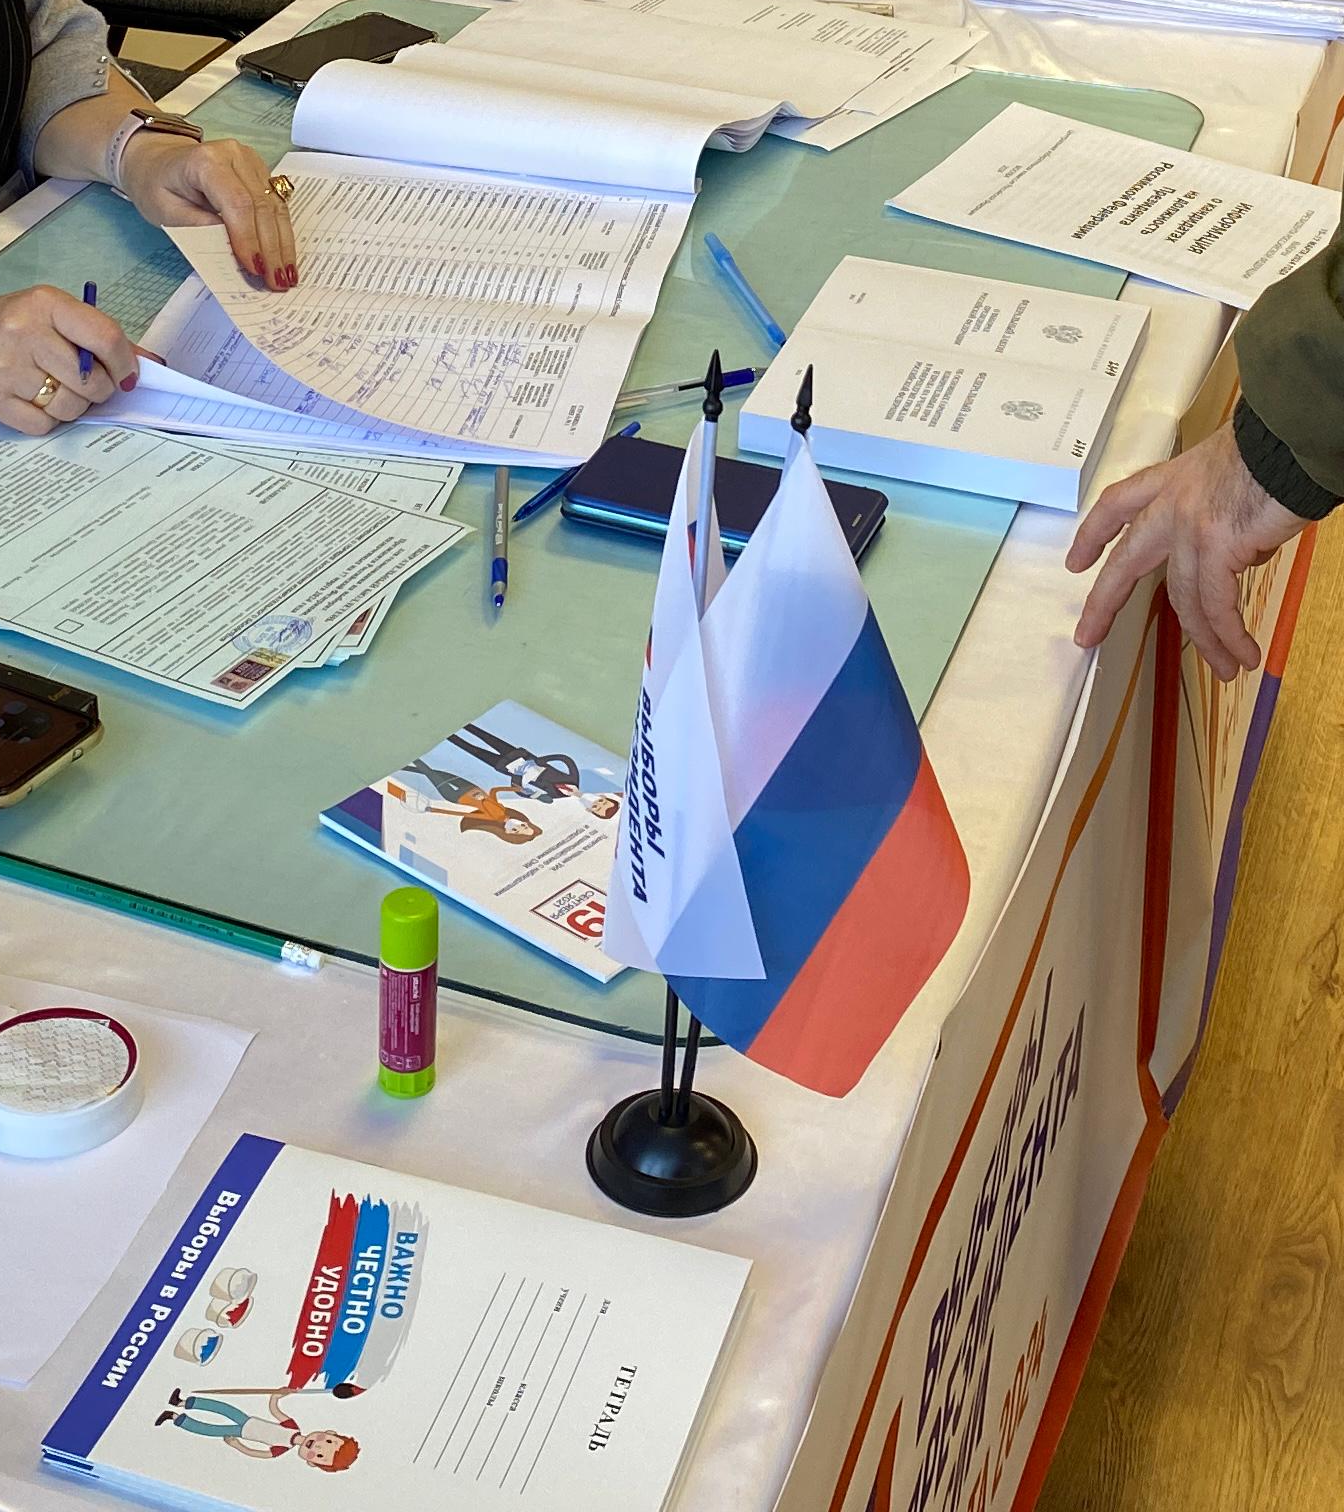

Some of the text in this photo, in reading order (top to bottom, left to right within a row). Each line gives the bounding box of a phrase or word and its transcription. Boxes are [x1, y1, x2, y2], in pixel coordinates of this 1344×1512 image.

[1071, 162, 1174, 239] Российской Федерации
[1119, 187, 1176, 225] Президента
[1141, 191, 1199, 234] на должность
[1165, 203, 1217, 243] кандидатах
[1187, 203, 1253, 254] ИНФОРМАЦИЯ
[642, 687, 665, 859] ВЫБОРЫ
[550, 891, 594, 919] СЕНТЯБРЯ
[553, 893, 576, 911] 2021
[916, 966, 1053, 1448] ВЫБОРЫ
[102, 1191, 241, 1387] Выборы в России
[343, 1246, 382, 1333] ЧЕСТНО
[381, 1232, 418, 1318] ВАЖНО
[302, 1266, 342, 1356] УДОБНО
[600, 1299, 611, 1314] для
[487, 1376, 505, 1406] школы
[509, 1383, 526, 1411] класса
[589, 1366, 637, 1451] ТЕТРАДЬ
